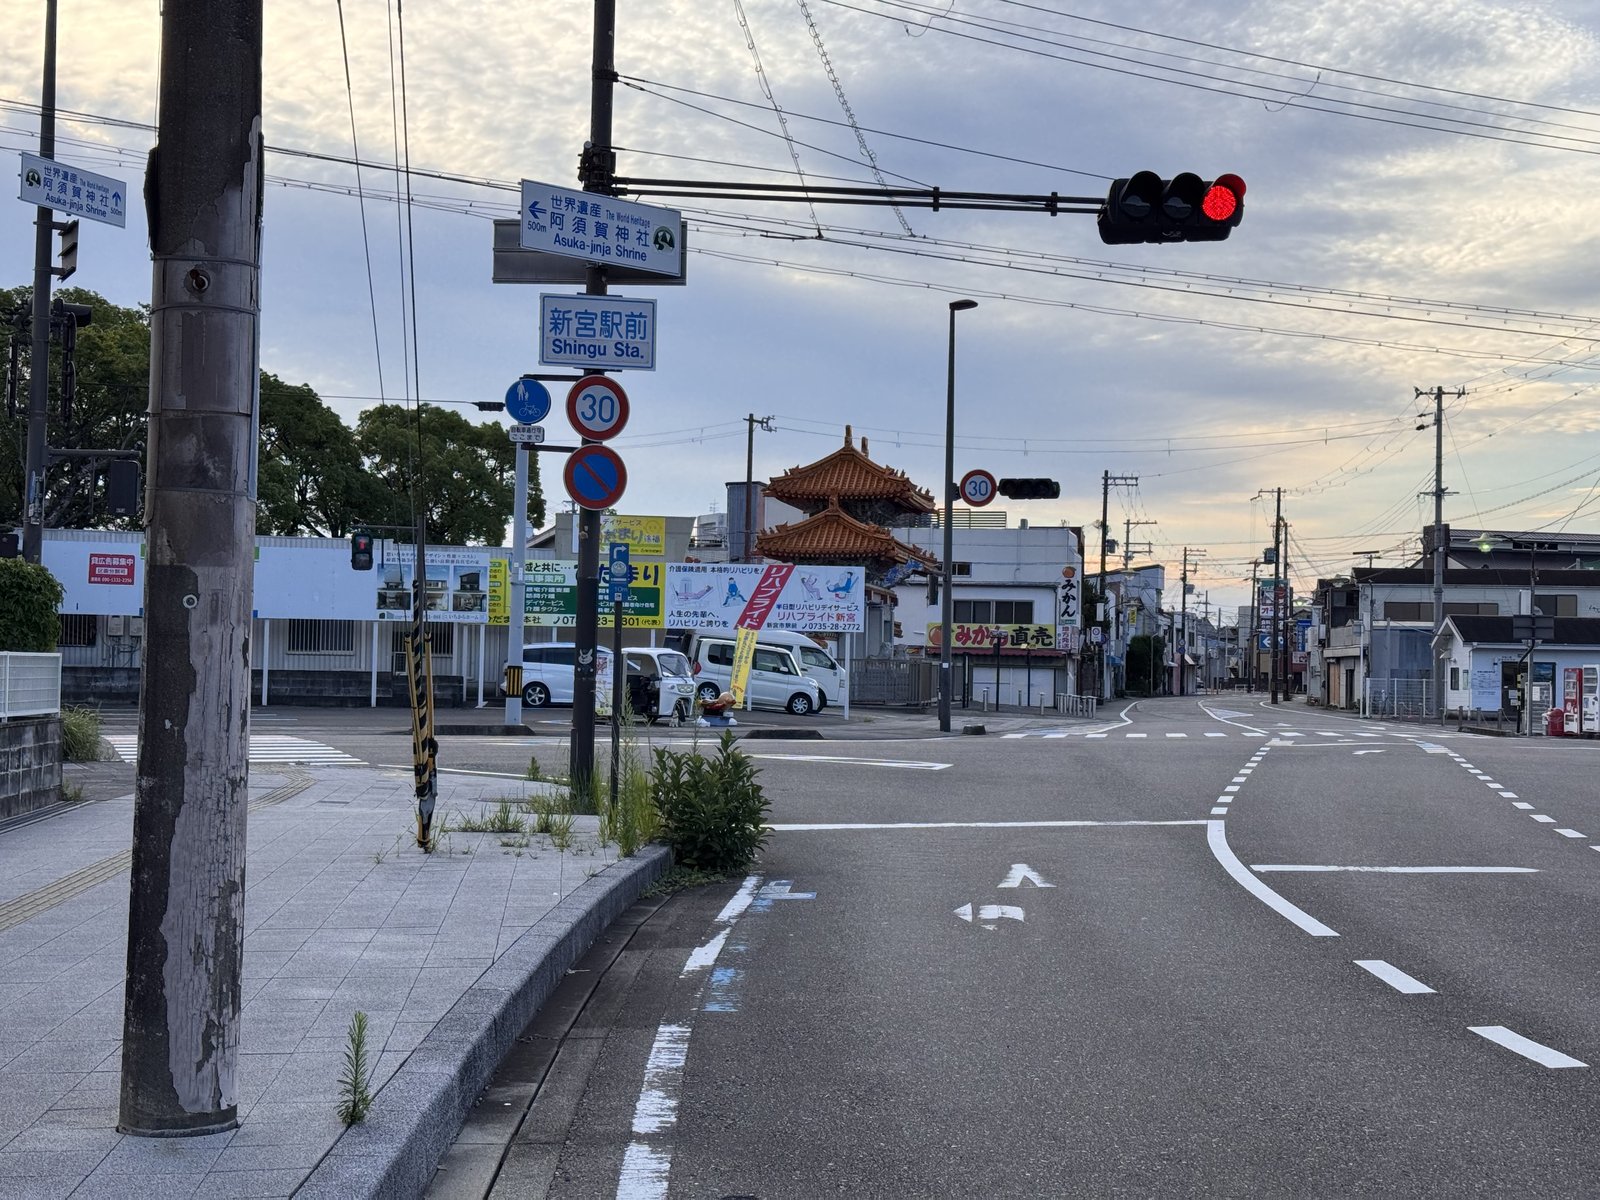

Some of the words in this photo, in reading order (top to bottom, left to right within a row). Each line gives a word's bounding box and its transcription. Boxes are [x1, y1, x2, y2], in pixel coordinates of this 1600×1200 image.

[44, 166, 78, 184] 世界遺産
[43, 177, 108, 208] 阿須賀神社
[46, 193, 83, 212] Asuka-jinja
[86, 205, 106, 217] Shrine
[110, 208, 122, 216] 500m
[550, 194, 602, 218] 世界遺産
[606, 210, 614, 220] The
[616, 212, 630, 224] World
[630, 215, 650, 228] Heritage
[528, 222, 546, 233] 500m
[550, 212, 650, 247] 阿須賀神社
[554, 233, 611, 256] Asuka-jinja
[615, 244, 647, 262] Shrine
[549, 307, 648, 340] 新宮駅前
[552, 339, 607, 358] Shingu
[614, 342, 644, 358] Sta.
[581, 394, 614, 423] 30
[968, 480, 988, 498] 30
[1061, 579, 1076, 618] みかん
[668, 610, 720, 618] 人生の先輩へ、
[808, 622, 860, 631] 0735-28-2772
